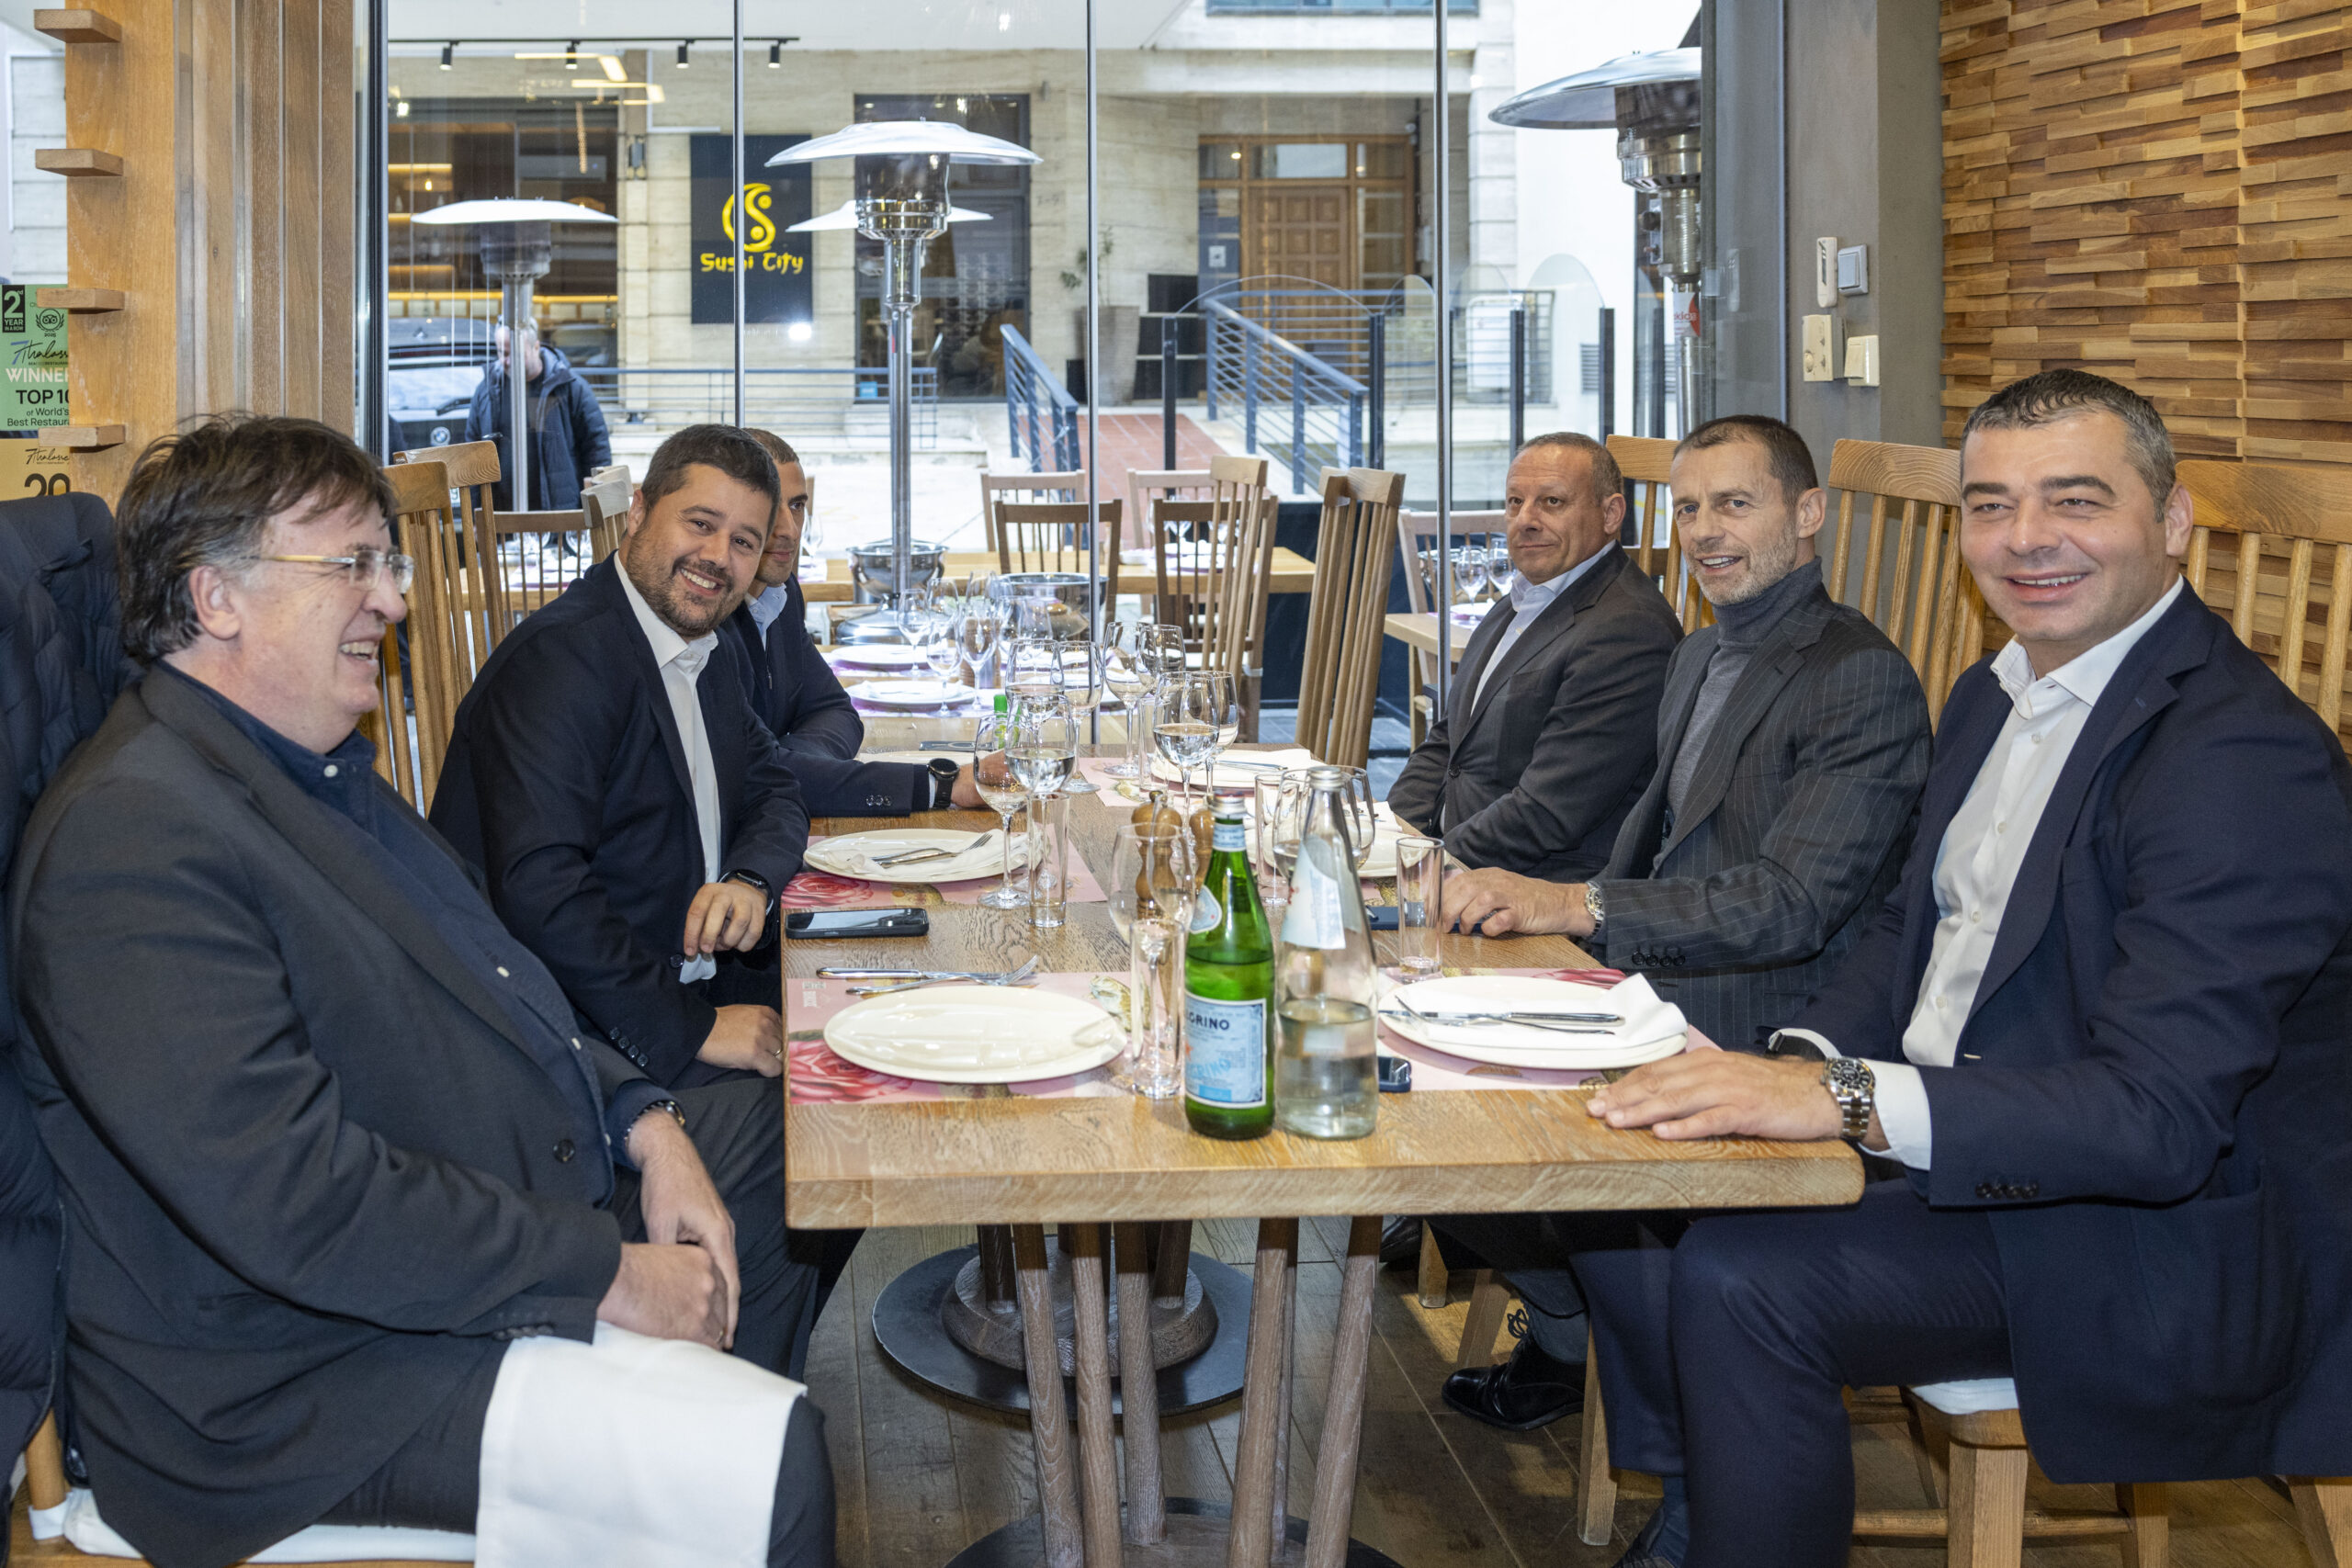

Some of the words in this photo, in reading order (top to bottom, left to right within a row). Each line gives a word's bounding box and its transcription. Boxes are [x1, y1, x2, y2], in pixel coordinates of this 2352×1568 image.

[762, 252, 804, 275] City
[16, 389, 53, 404] TOP
[35, 407, 70, 416] World's
[7, 418, 28, 426] Best
